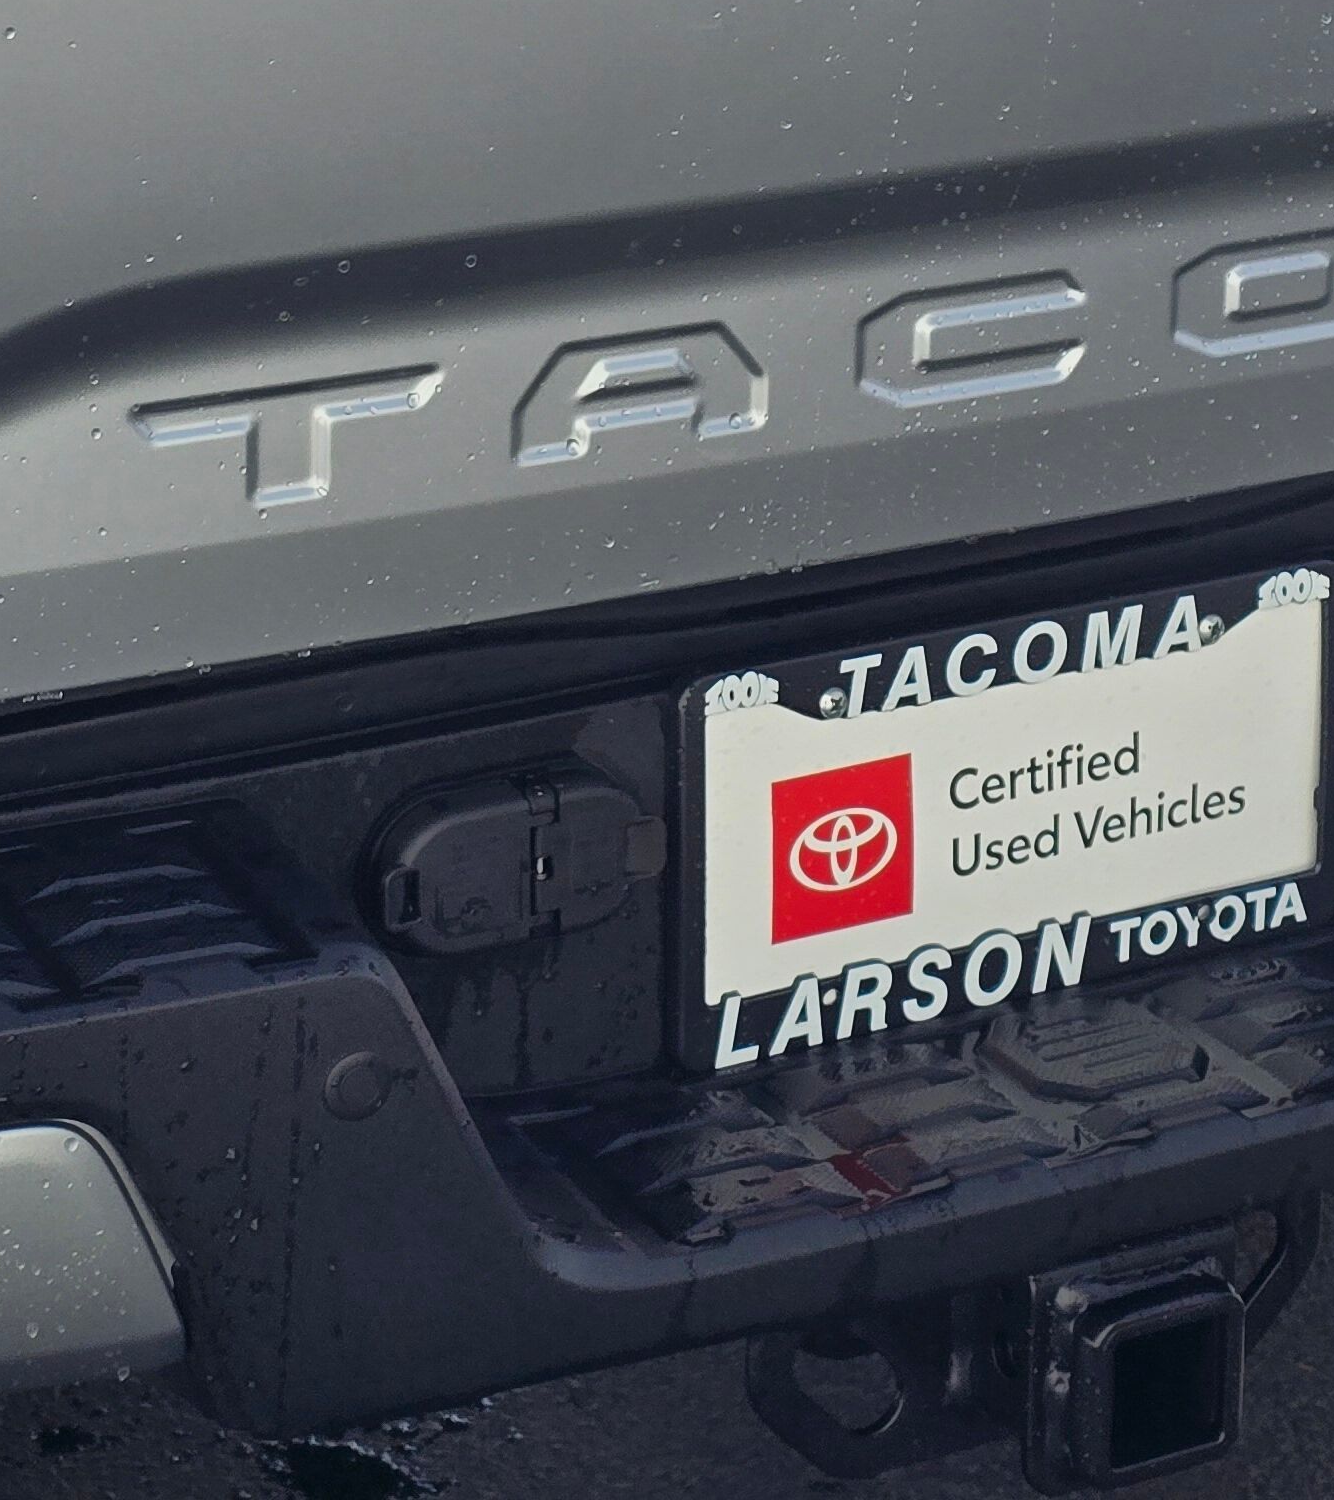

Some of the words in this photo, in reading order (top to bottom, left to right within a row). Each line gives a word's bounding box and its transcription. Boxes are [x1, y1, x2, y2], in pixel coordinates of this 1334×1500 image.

[838, 595, 1204, 719] TACOMA
[949, 731, 1141, 809] Certified
[951, 817, 1061, 877] Used
[1073, 783, 1247, 849] Vehicles
[714, 911, 1091, 1069] LARSON
[1109, 882, 1308, 963] TOYOTA
